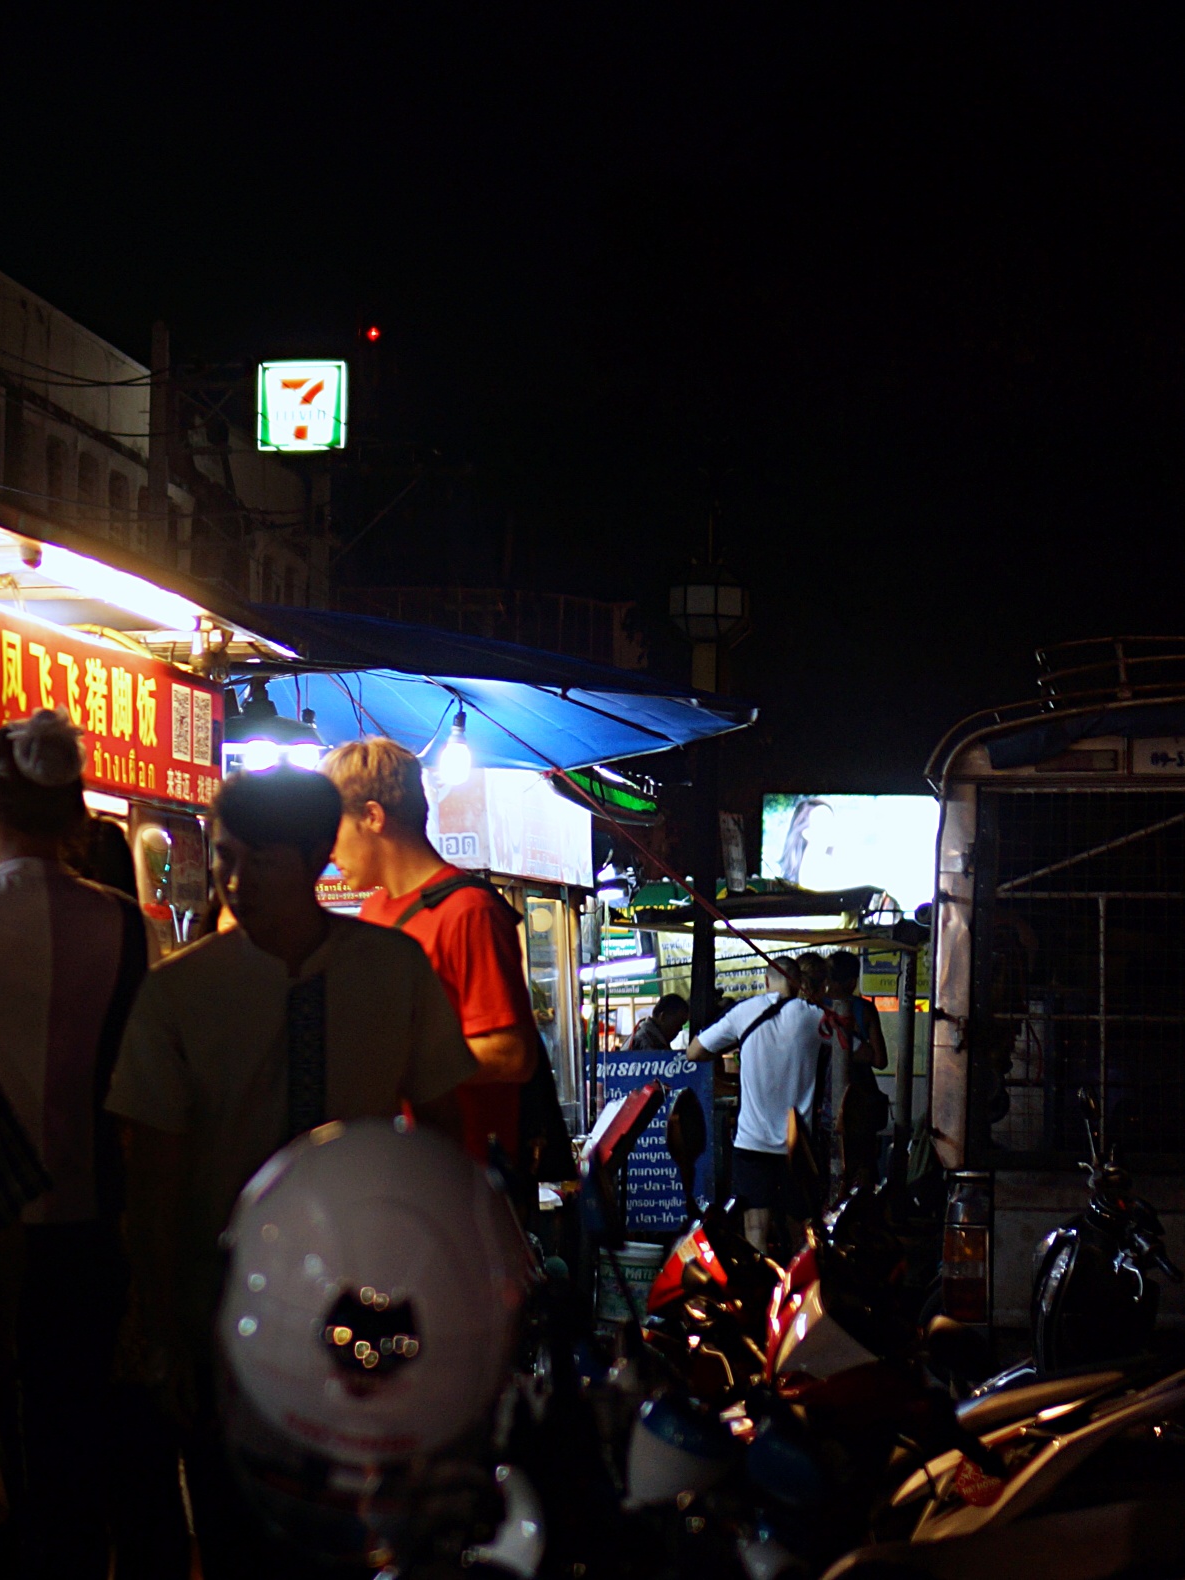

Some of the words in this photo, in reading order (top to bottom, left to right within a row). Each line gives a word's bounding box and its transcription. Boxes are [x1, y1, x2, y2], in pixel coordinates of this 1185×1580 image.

[1, 629, 158, 747] 凤飞飞猪脚饭
